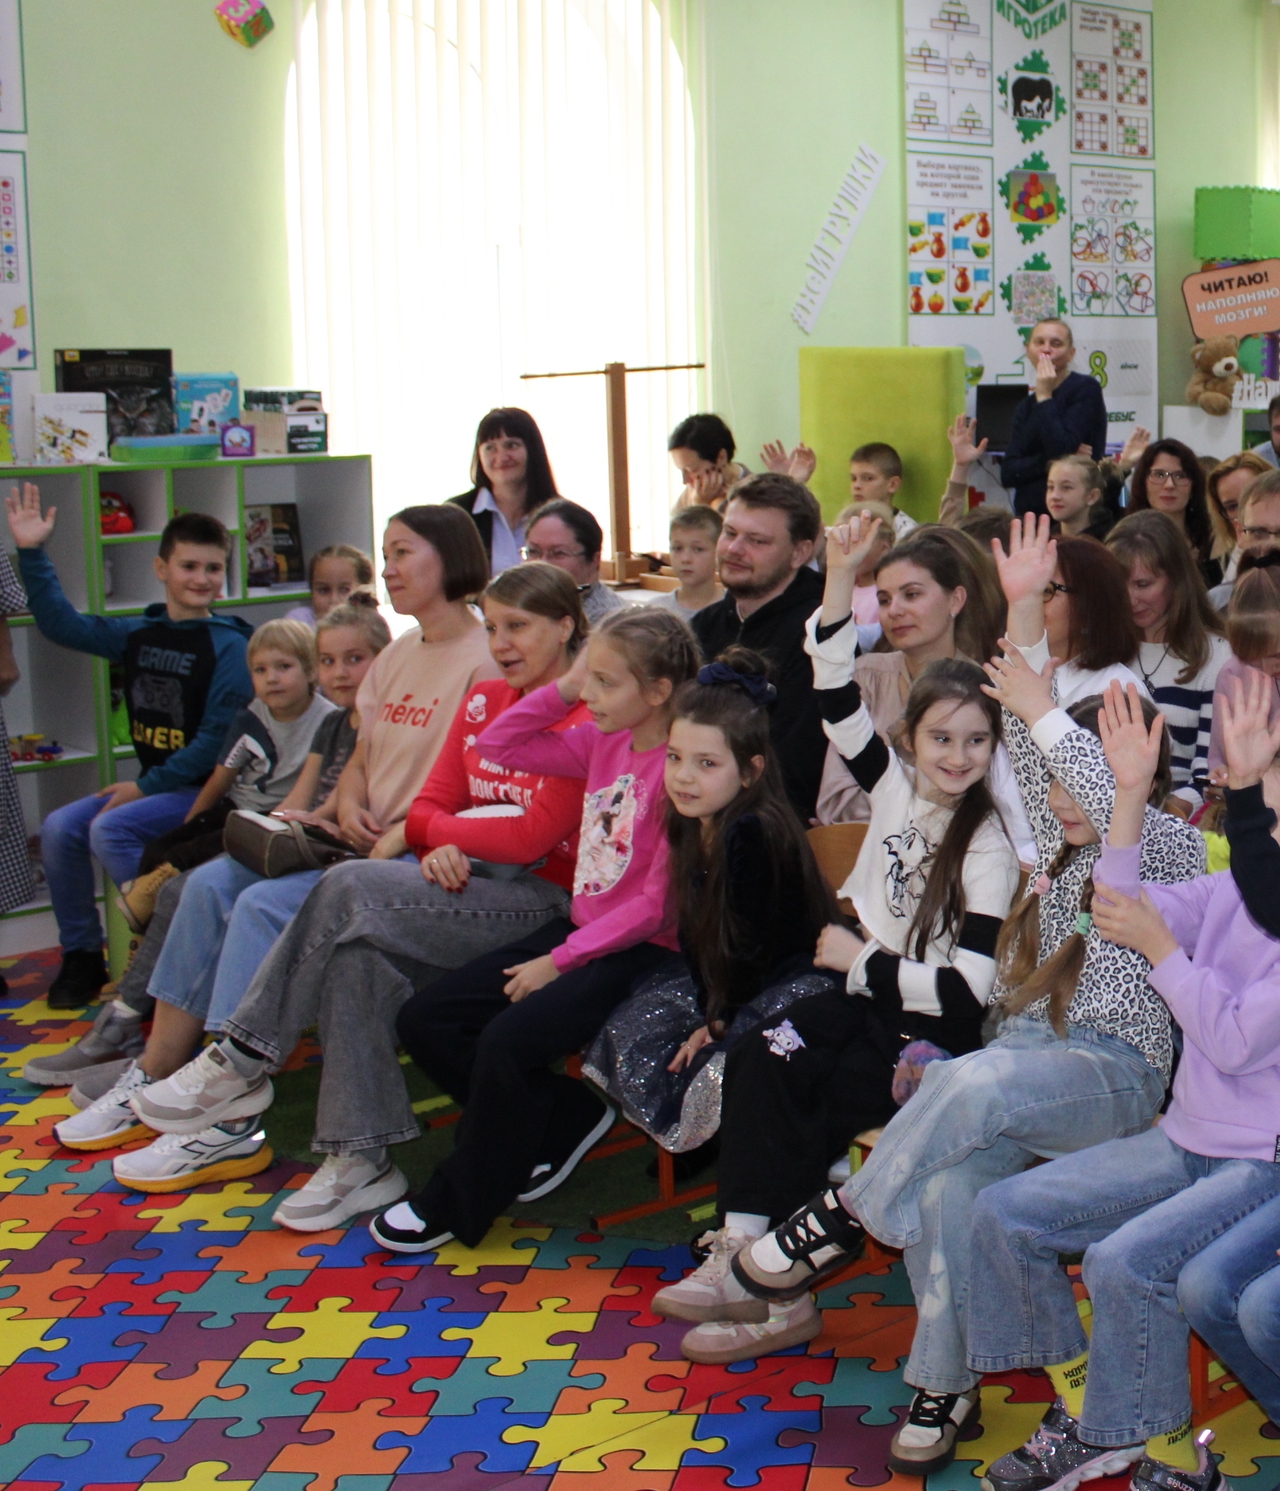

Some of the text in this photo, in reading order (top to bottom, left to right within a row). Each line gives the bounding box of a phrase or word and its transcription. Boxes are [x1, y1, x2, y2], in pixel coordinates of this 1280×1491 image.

[996, 0, 1067, 40] ИГРОТЕКА
[1200, 270, 1269, 294] ЧИТАЮ!
[1196, 287, 1280, 313] НАПОЛНЯЮ
[1214, 305, 1268, 325] МОЗГИ!
[1107, 411, 1136, 422] ЕБУС
[137, 645, 196, 676] GAME
